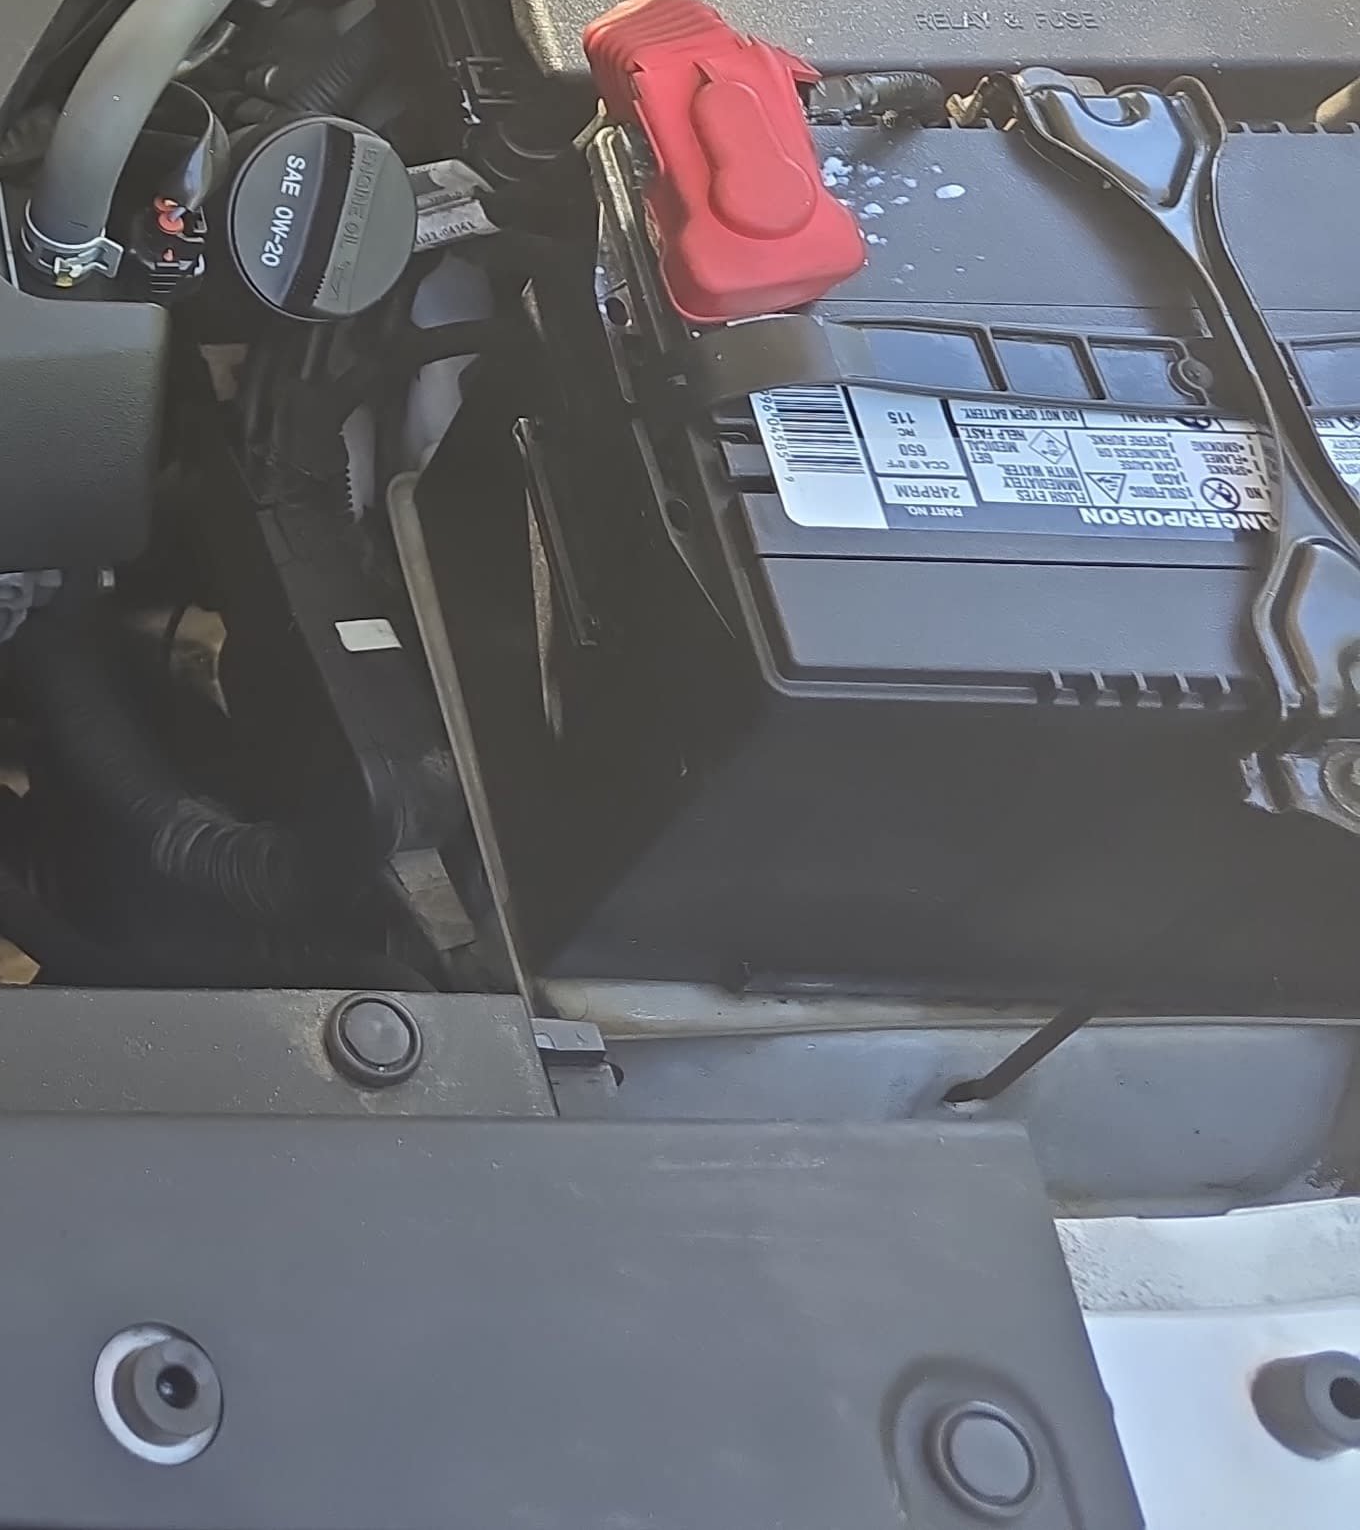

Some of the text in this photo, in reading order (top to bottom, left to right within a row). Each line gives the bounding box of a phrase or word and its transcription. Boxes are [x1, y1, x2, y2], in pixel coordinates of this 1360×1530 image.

[914, 11, 1101, 31] RELAY & FUSE
[348, 147, 379, 220] ENGINE
[260, 153, 307, 268] SAE 0W-20
[887, 411, 916, 425] 115
[1009, 408, 1037, 420] OPEN
[1039, 409, 1062, 421] NOT
[1064, 410, 1079, 421] DO
[897, 428, 916, 437] RC
[996, 428, 1028, 441] HELP
[963, 440, 1020, 453] MEDICAL
[1127, 435, 1168, 447] SEVERE
[899, 442, 927, 456] 650
[908, 459, 920, 469] @
[970, 452, 994, 464] GET
[1201, 453, 1243, 465] FLAMES
[923, 460, 950, 470] CCA
[1044, 465, 1079, 478] WITH
[1155, 460, 1178, 471] CAN
[1002, 476, 1081, 491] IMMEDIATELY
[1151, 473, 1179, 485] ACID
[896, 483, 961, 499] 24RPRM
[1016, 489, 1088, 504] FLUSH EYES
[1129, 486, 1189, 500] SULFURIC
[1244, 486, 1265, 500] NO
[903, 505, 964, 518] PART NO.
[1078, 507, 1273, 532] ANGER/POISON
